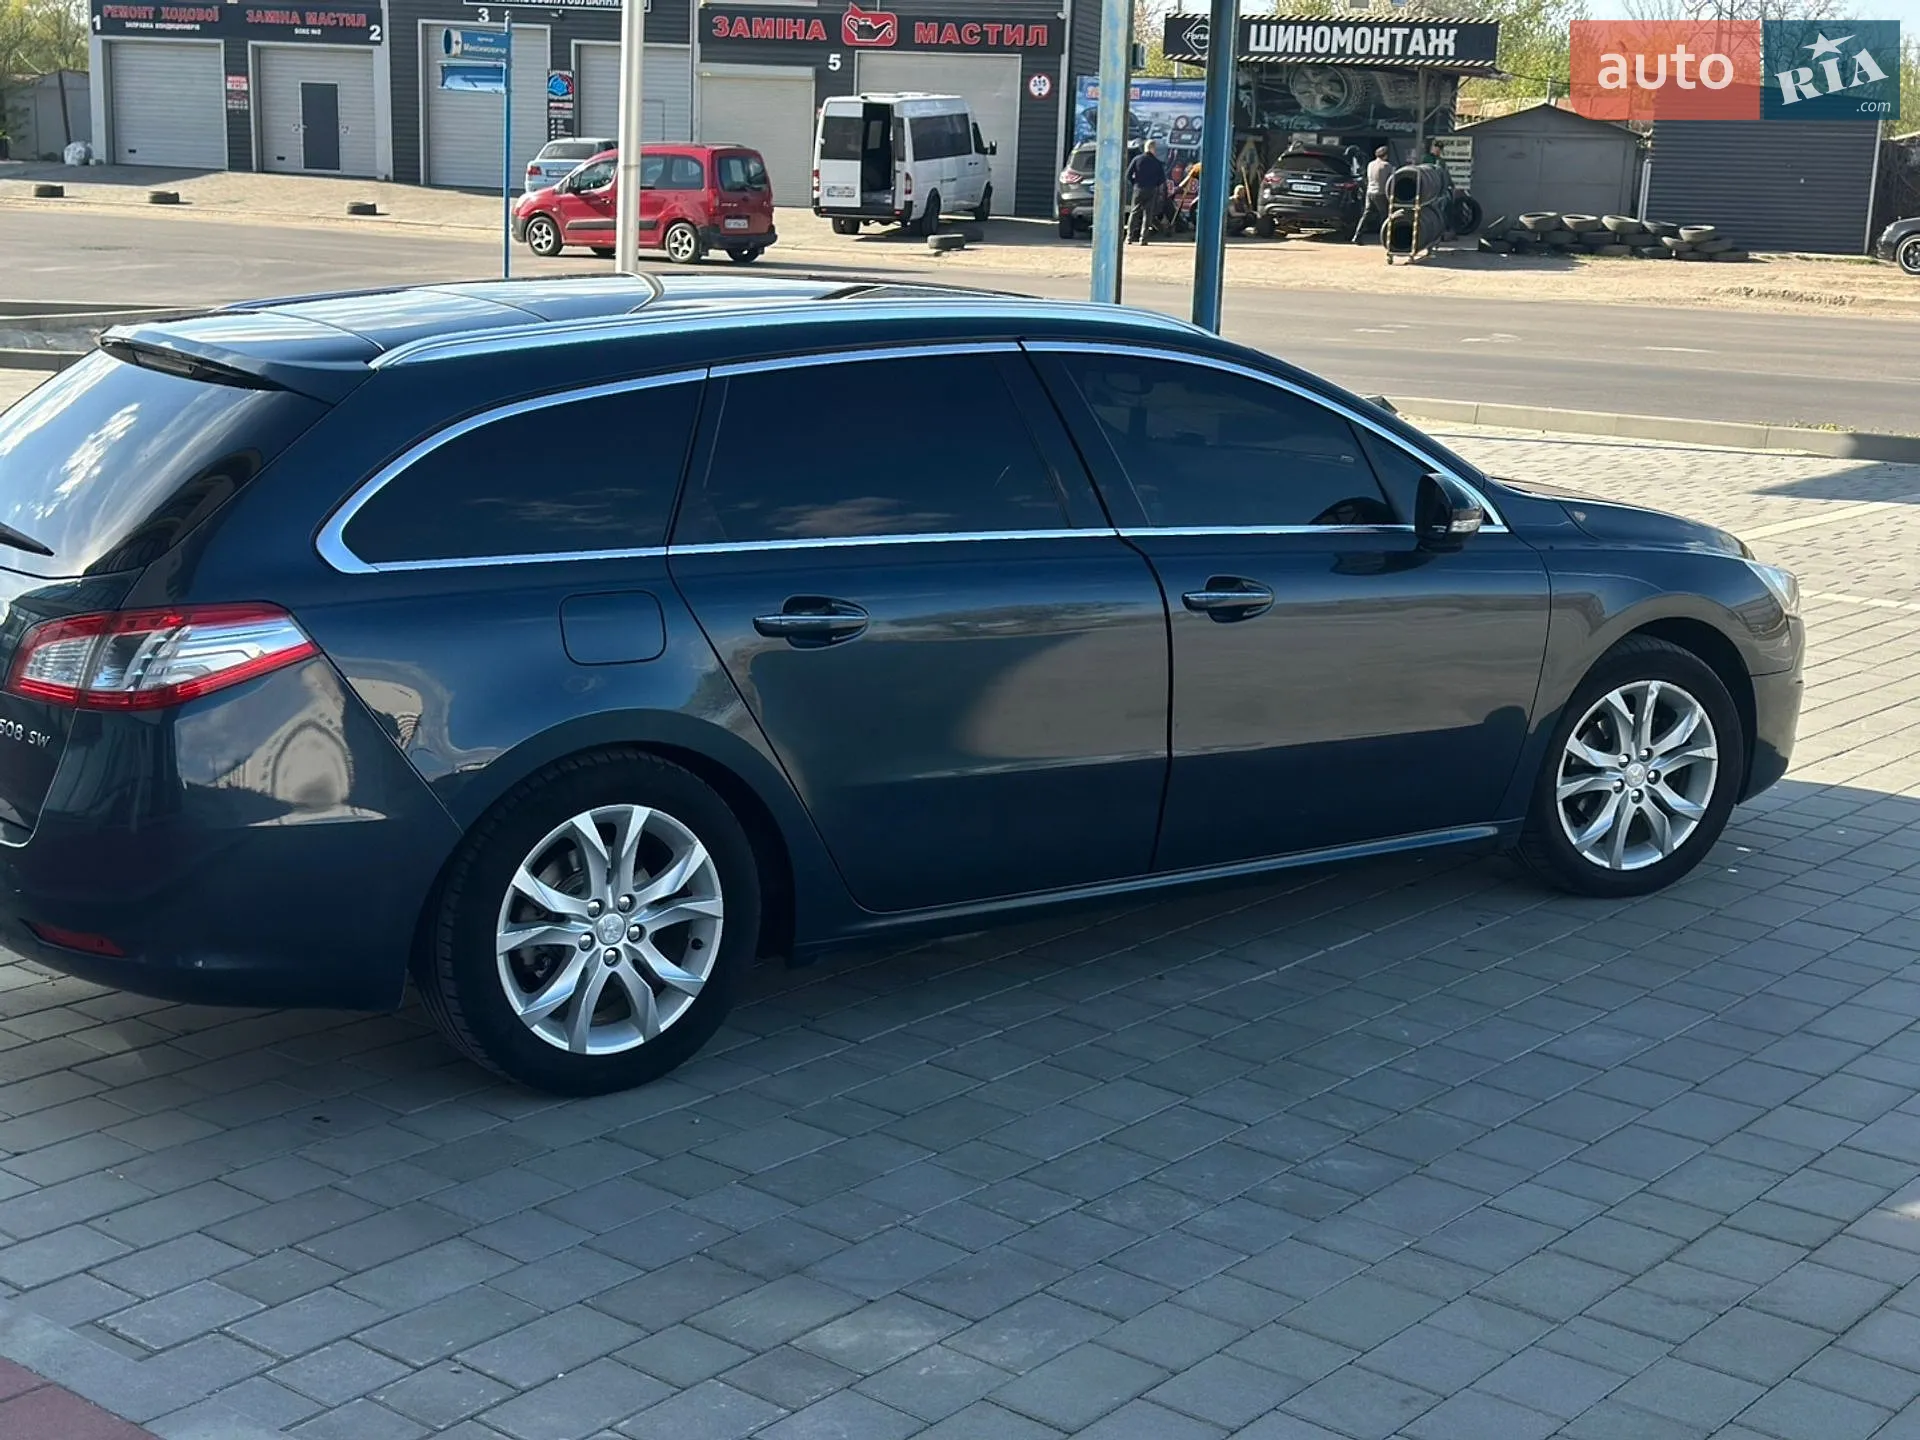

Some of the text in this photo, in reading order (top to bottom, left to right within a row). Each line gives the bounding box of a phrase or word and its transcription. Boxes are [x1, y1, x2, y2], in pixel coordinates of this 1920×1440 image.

[102, 5, 220, 21] РЕМОНТ ХОДОВОЇ
[245, 9, 367, 27] ЗАМІНА МАСТИЛ
[478, 8, 490, 23] 3
[92, 14, 101, 31] 1
[712, 15, 1048, 47] ЗАМІНА МАСТИЛ
[369, 24, 382, 41] 2
[1249, 23, 1457, 56] ШИНОМОНТАЖ
[828, 53, 842, 71] 5
[28, 730, 51, 748] SW
